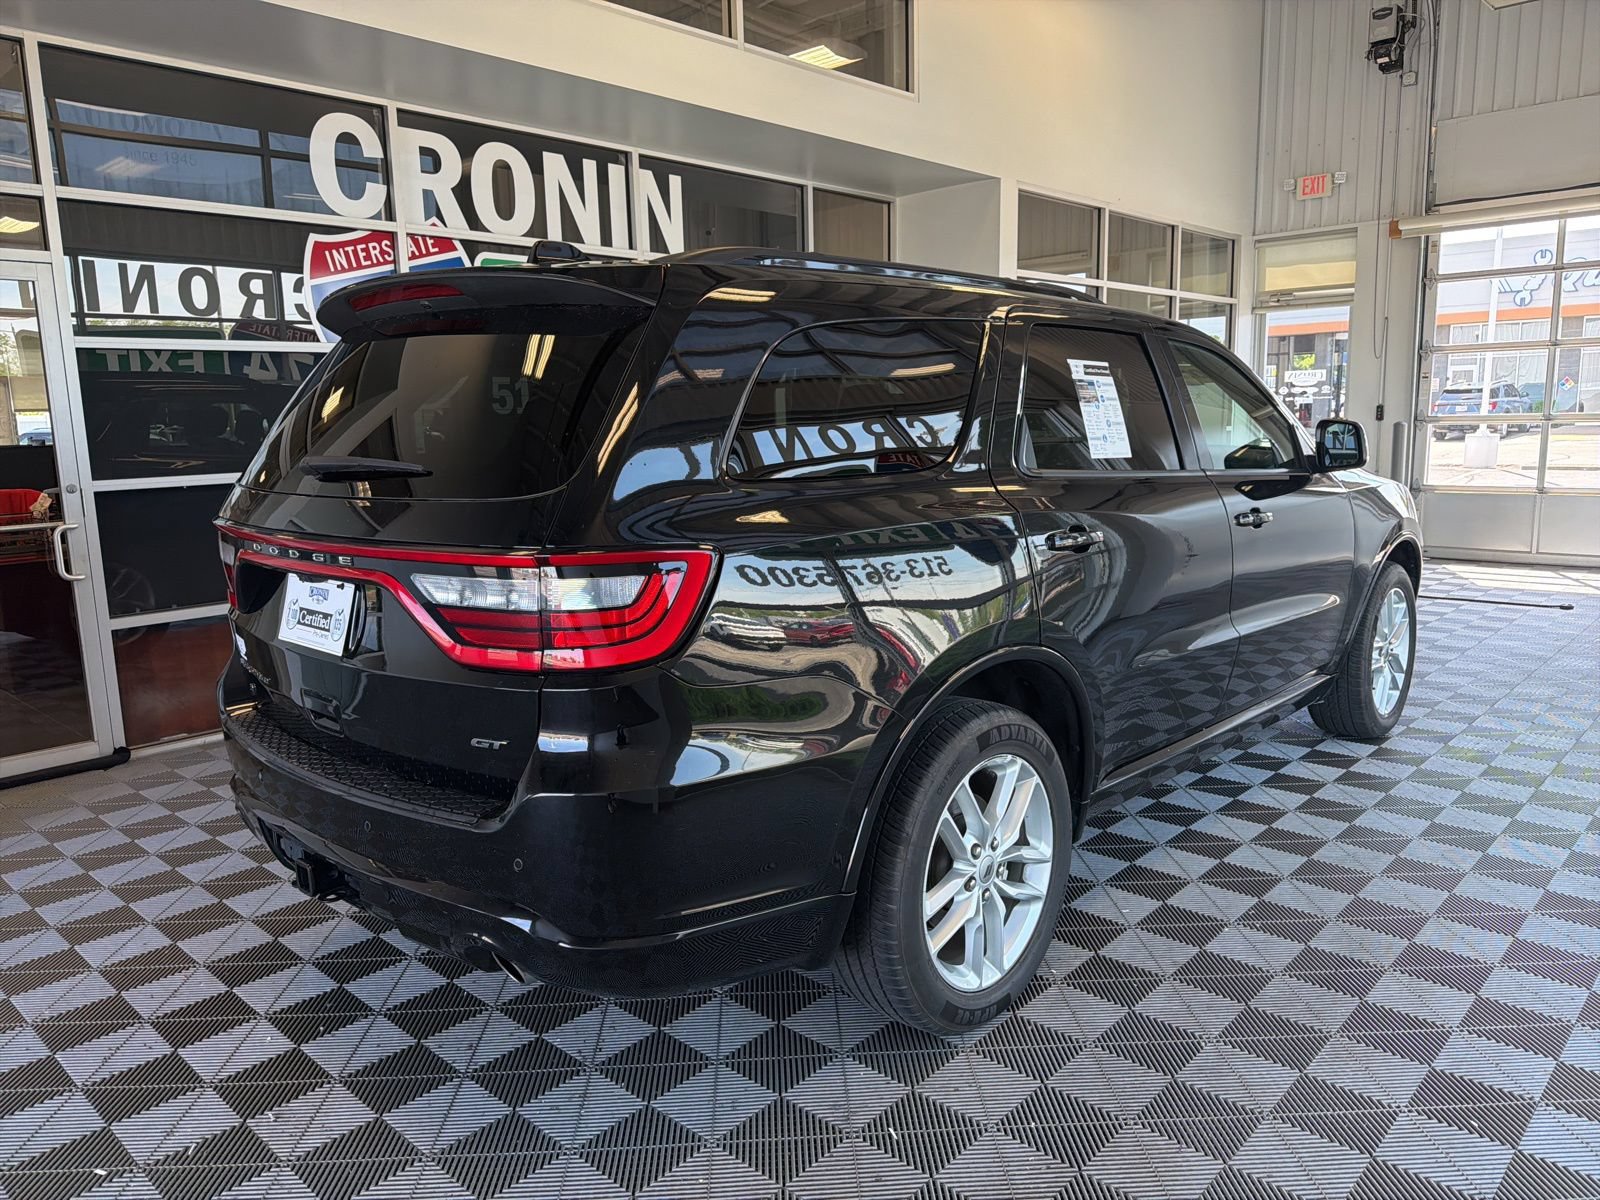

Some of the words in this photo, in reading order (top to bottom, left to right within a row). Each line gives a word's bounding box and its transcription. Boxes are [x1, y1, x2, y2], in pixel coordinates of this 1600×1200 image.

[309, 111, 684, 255] CRONIN
[1301, 175, 1327, 196] EXIT
[324, 234, 441, 273] INTERSATE
[253, 543, 353, 566] DODGE
[299, 610, 331, 630] Certified
[470, 737, 510, 750] GT
[989, 724, 1049, 757] ADVANTA
